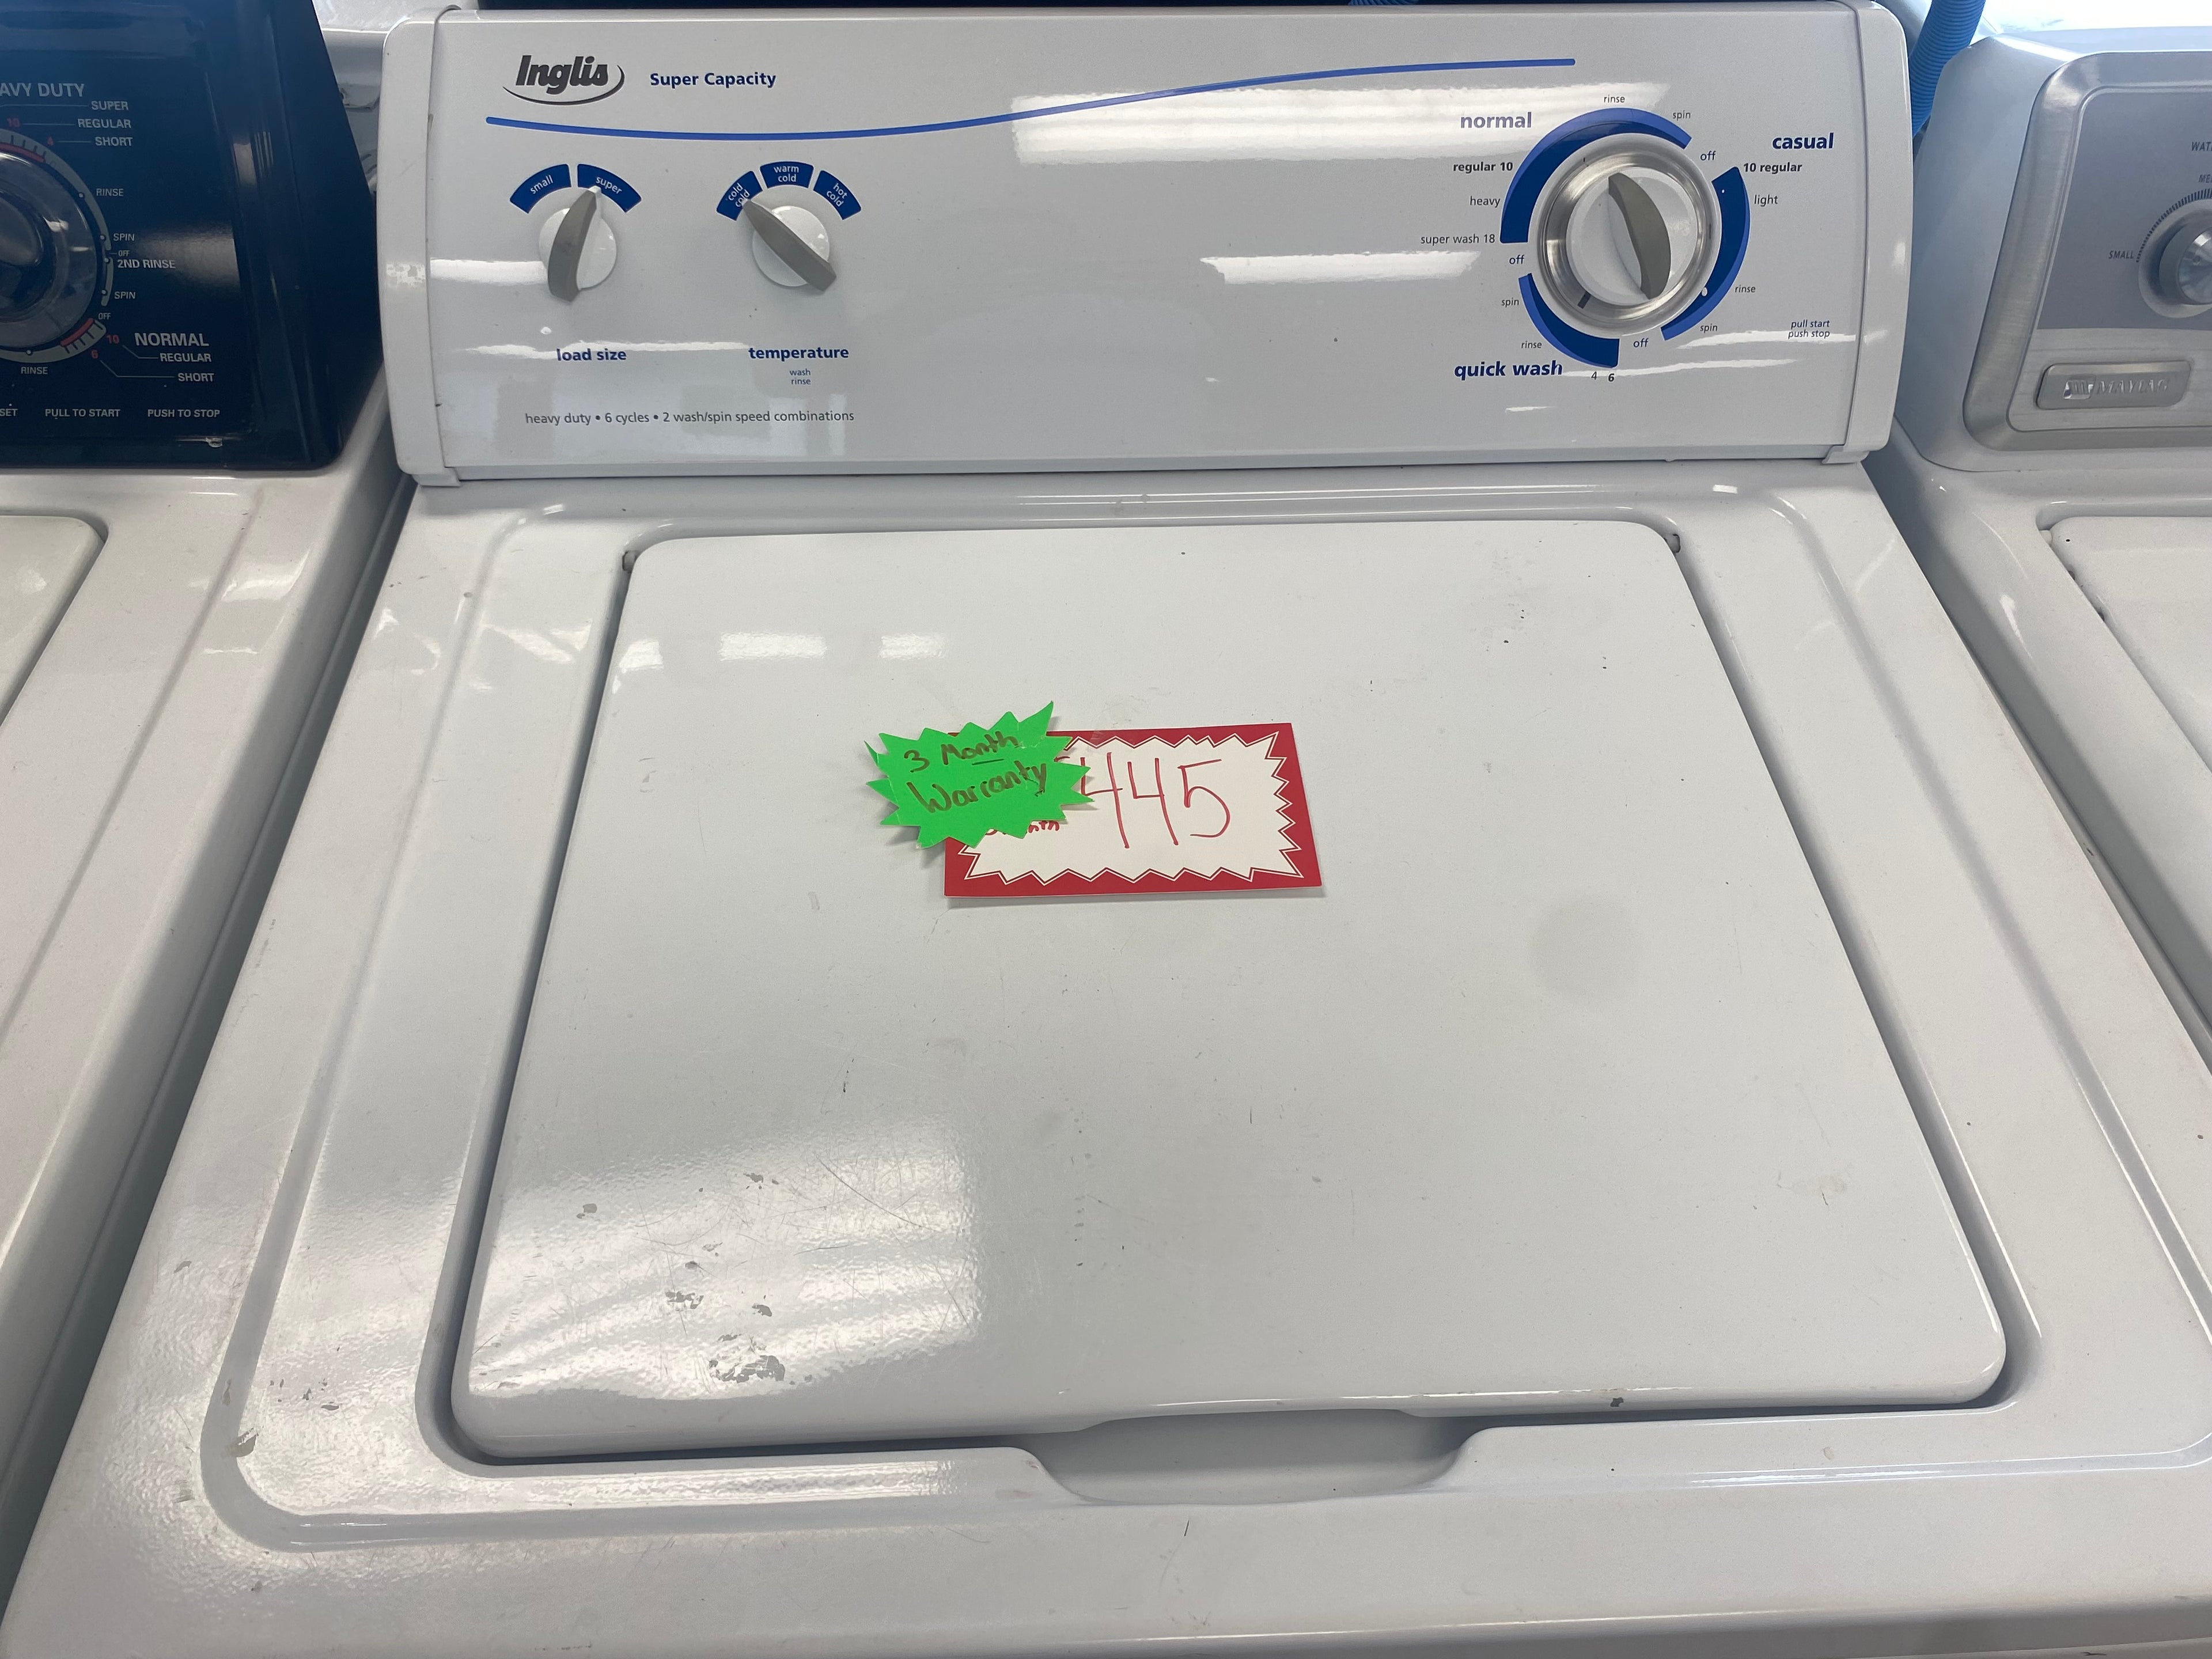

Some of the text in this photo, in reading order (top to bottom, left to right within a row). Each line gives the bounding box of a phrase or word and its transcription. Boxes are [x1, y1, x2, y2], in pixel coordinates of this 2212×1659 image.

[516, 55, 609, 94] Inglis
[650, 72, 777, 88] Super Capacity
[37, 82, 85, 97] DUTY
[1603, 94, 1626, 104] rinse
[91, 100, 129, 111] SUPER
[1460, 112, 1532, 128] normal
[1672, 111, 1691, 121] spin
[78, 119, 132, 128] REGULAR
[95, 137, 133, 146] SHORT
[1772, 132, 1835, 150] casual
[2191, 141, 2212, 151] WAT
[1700, 150, 1716, 161] off
[774, 165, 800, 173] warm
[1453, 161, 1513, 174] regular 10
[1743, 162, 1802, 174] 10 regular
[778, 173, 797, 183] cold
[2198, 174, 2212, 183] ME
[530, 175, 554, 194] small
[596, 176, 623, 195] super
[96, 188, 124, 197] RINSE
[728, 182, 744, 202] cold
[833, 183, 847, 199] hot
[735, 189, 750, 208] cold
[826, 190, 844, 207] cold
[1469, 196, 1501, 208] heavy
[1754, 195, 1778, 207] light
[113, 233, 135, 242] SPIN
[1421, 234, 1495, 246] super wash 18
[1509, 255, 1525, 265] off
[2108, 250, 2134, 260] SMALL
[118, 259, 176, 269] 2ND RINSE
[1734, 285, 1756, 293] rinse
[115, 291, 135, 300] SPIN
[1501, 297, 1519, 308] spin
[98, 312, 111, 320] OFF
[1700, 323, 1718, 333] spin
[1791, 320, 1830, 329] pull start
[107, 332, 209, 346] 10 NORMAL
[1788, 329, 1830, 339] push stop
[1521, 340, 1542, 349] rinse
[1633, 338, 1649, 348] off
[160, 353, 212, 363] REGULAR
[556, 348, 627, 361] load size
[749, 347, 849, 362] temperature
[21, 366, 48, 375] RINSE
[91, 349, 214, 382] 6 SHORT
[1454, 360, 1563, 381] quick wash
[789, 368, 811, 376] wash
[1591, 371, 1615, 382] 4 6
[791, 377, 811, 385] rinse
[45, 408, 120, 418] PULL TO START
[147, 409, 220, 418] PUSH TO STOP
[525, 410, 854, 426] heavy duty 6 cycles 2 wash/spin speed combinations
[904, 730, 1020, 773] 3 Month
[906, 760, 1047, 813] Warranty
[1053, 752, 1230, 849] 445
